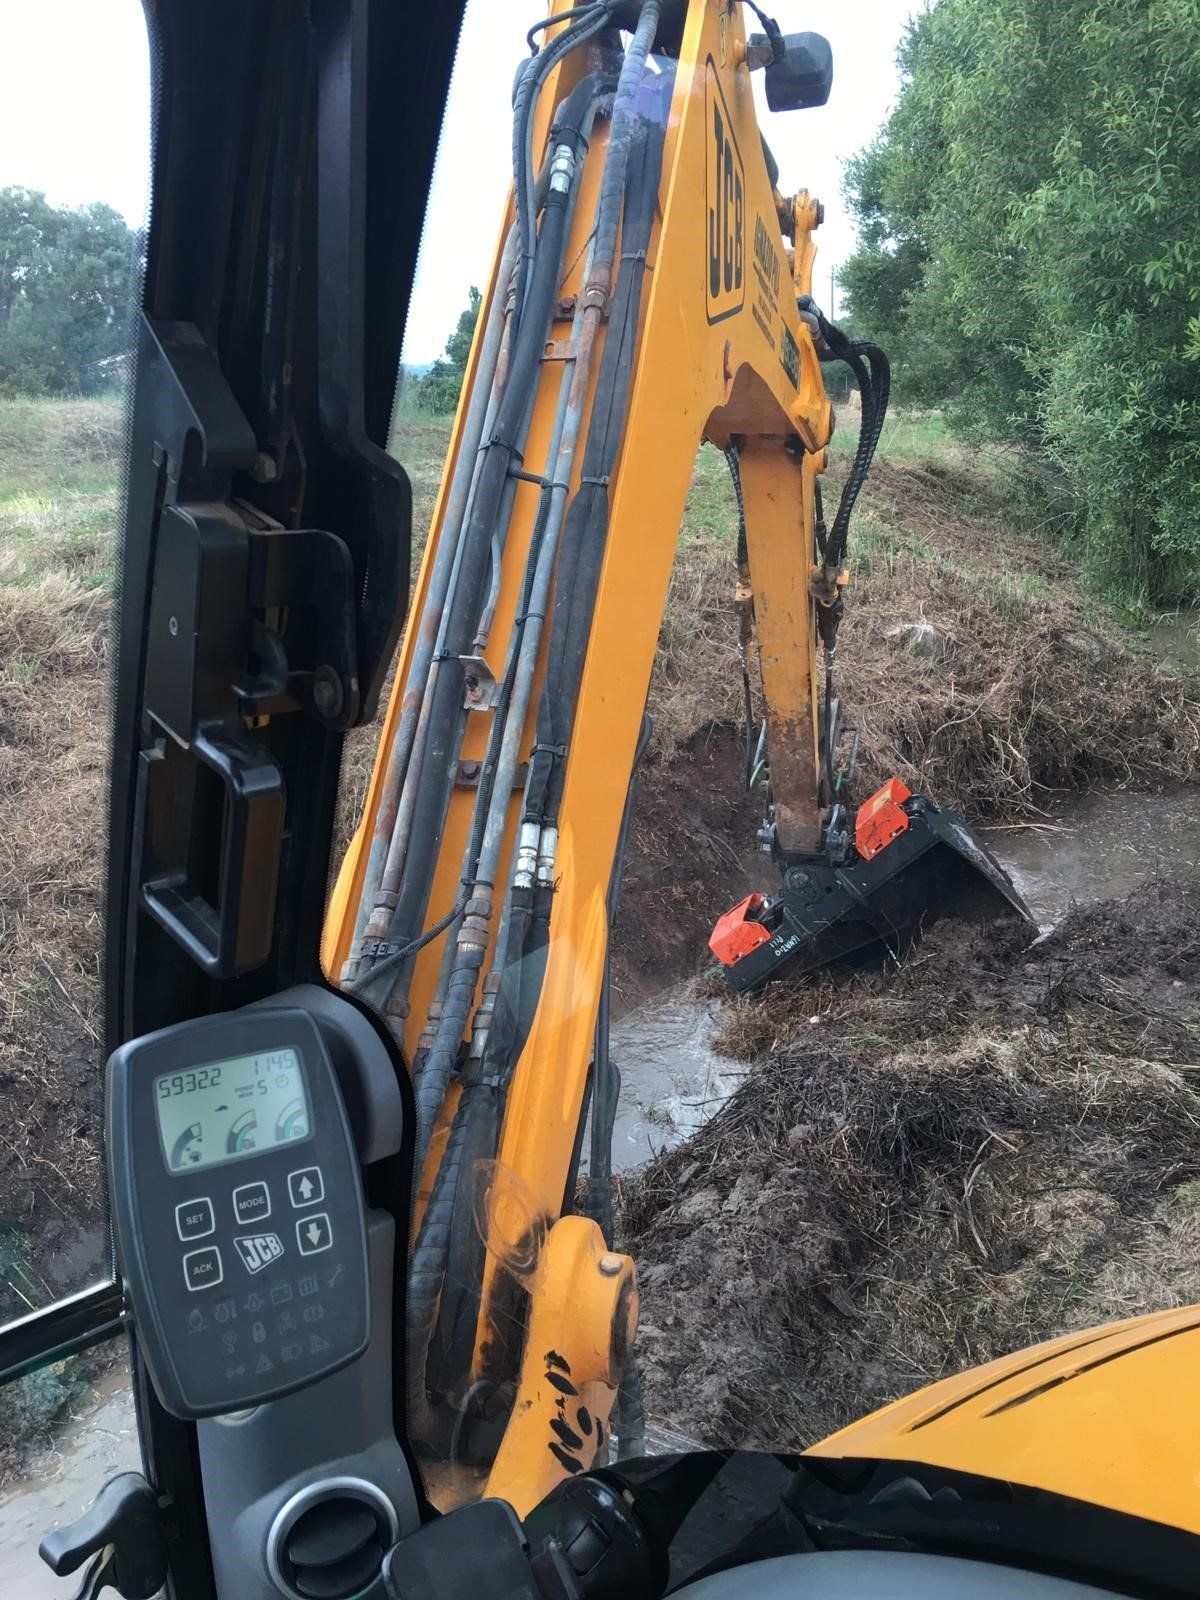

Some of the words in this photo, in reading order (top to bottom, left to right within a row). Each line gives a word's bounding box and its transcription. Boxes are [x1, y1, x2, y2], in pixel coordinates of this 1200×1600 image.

[709, 96, 743, 299] JCB
[159, 1067, 222, 1099] 59322
[238, 1196, 266, 1210] MODE
[185, 1213, 204, 1226] SET
[242, 1236, 281, 1270] JCB
[193, 1261, 214, 1276] ACK
